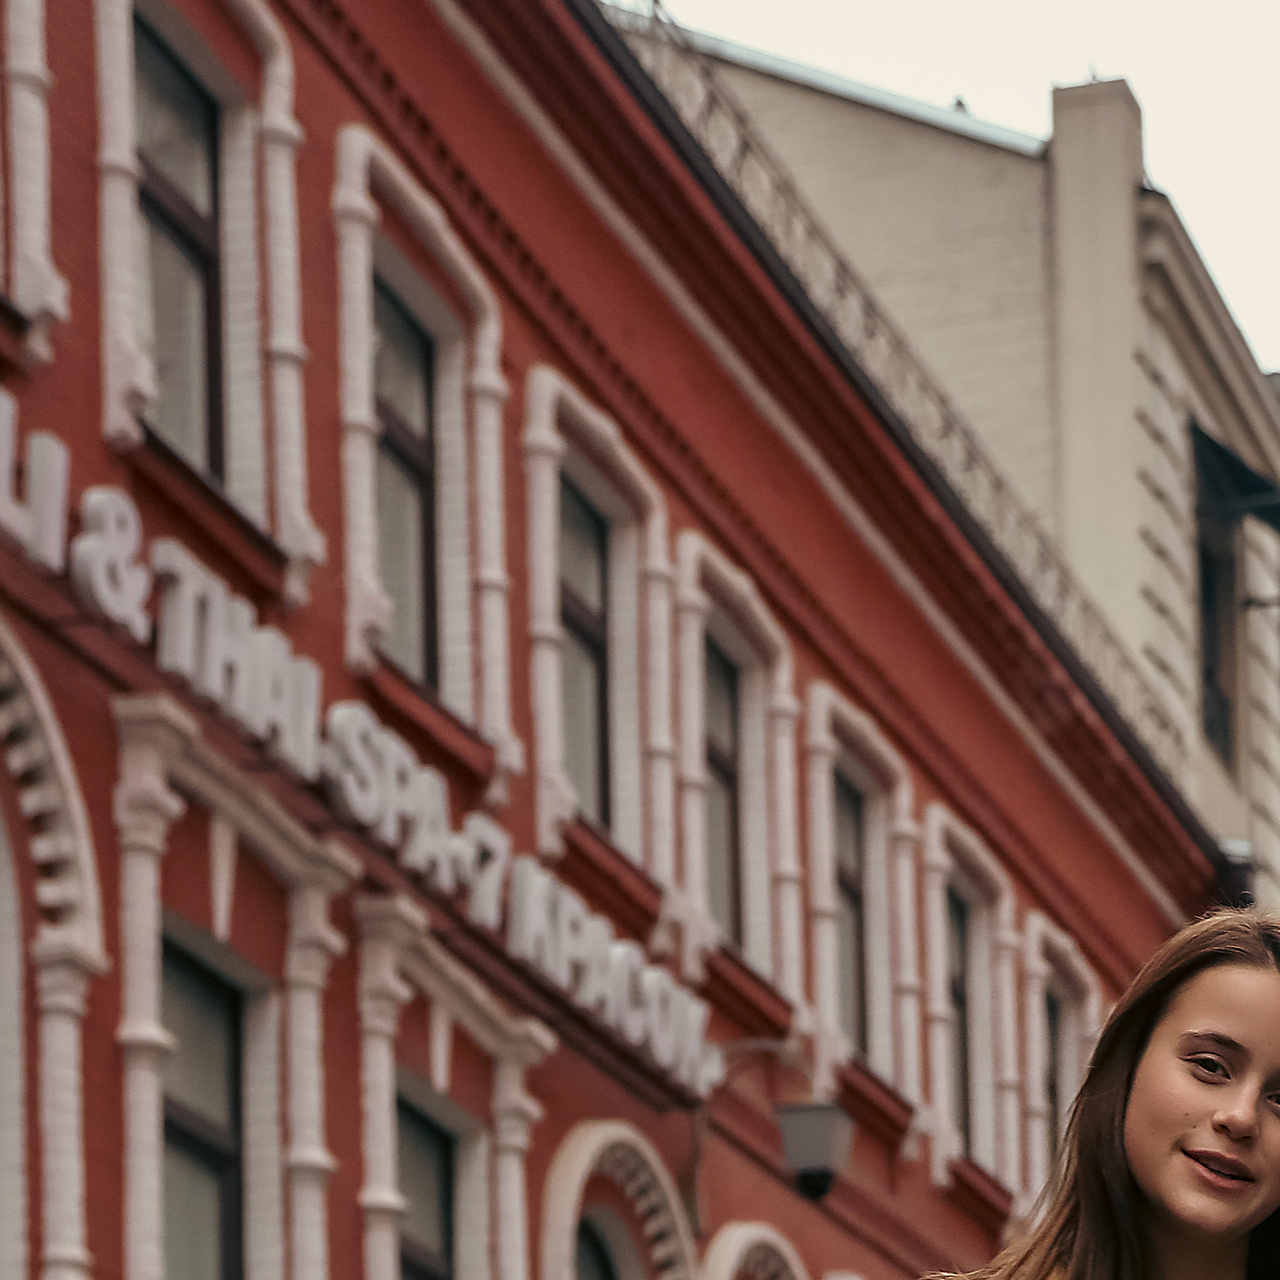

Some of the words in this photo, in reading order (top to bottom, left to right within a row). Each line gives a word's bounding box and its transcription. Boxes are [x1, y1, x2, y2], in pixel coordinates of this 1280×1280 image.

[70, 485, 150, 643] &
[149, 537, 322, 782] THAI
[325, 699, 449, 895] SPA
[448, 813, 511, 928] 7
